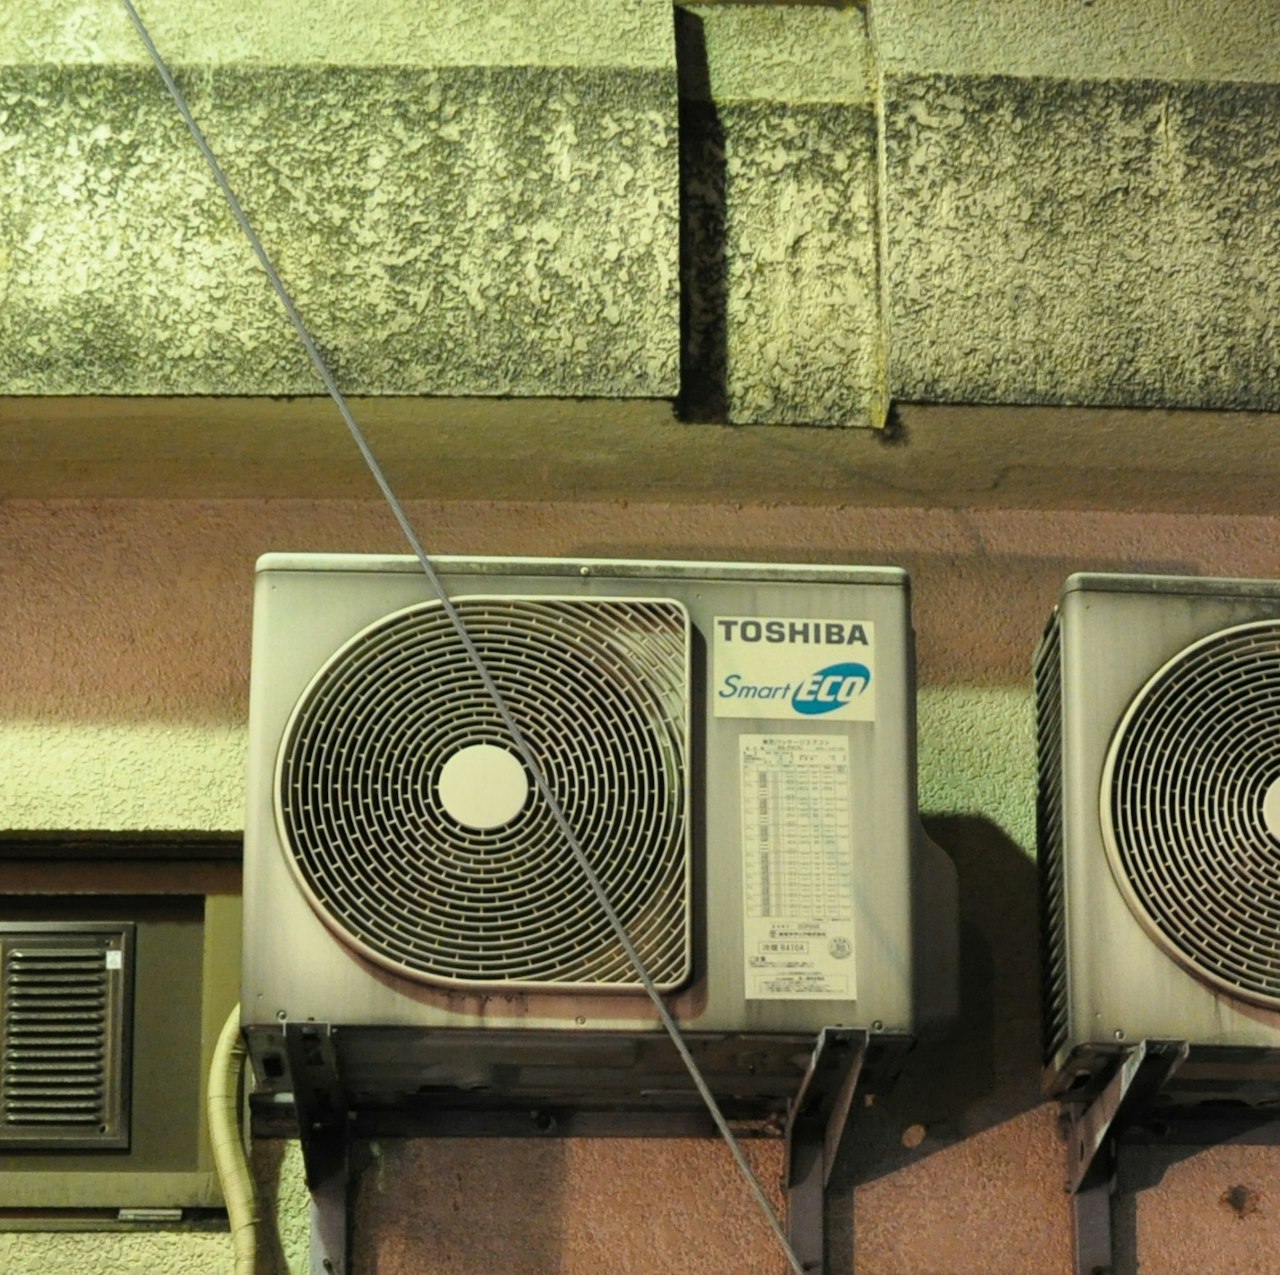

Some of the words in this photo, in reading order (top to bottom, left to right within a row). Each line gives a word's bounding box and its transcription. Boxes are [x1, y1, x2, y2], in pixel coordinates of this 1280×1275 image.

[718, 620, 869, 646] TOSHIBA
[718, 673, 790, 700] Smart
[797, 675, 866, 703] ECO
